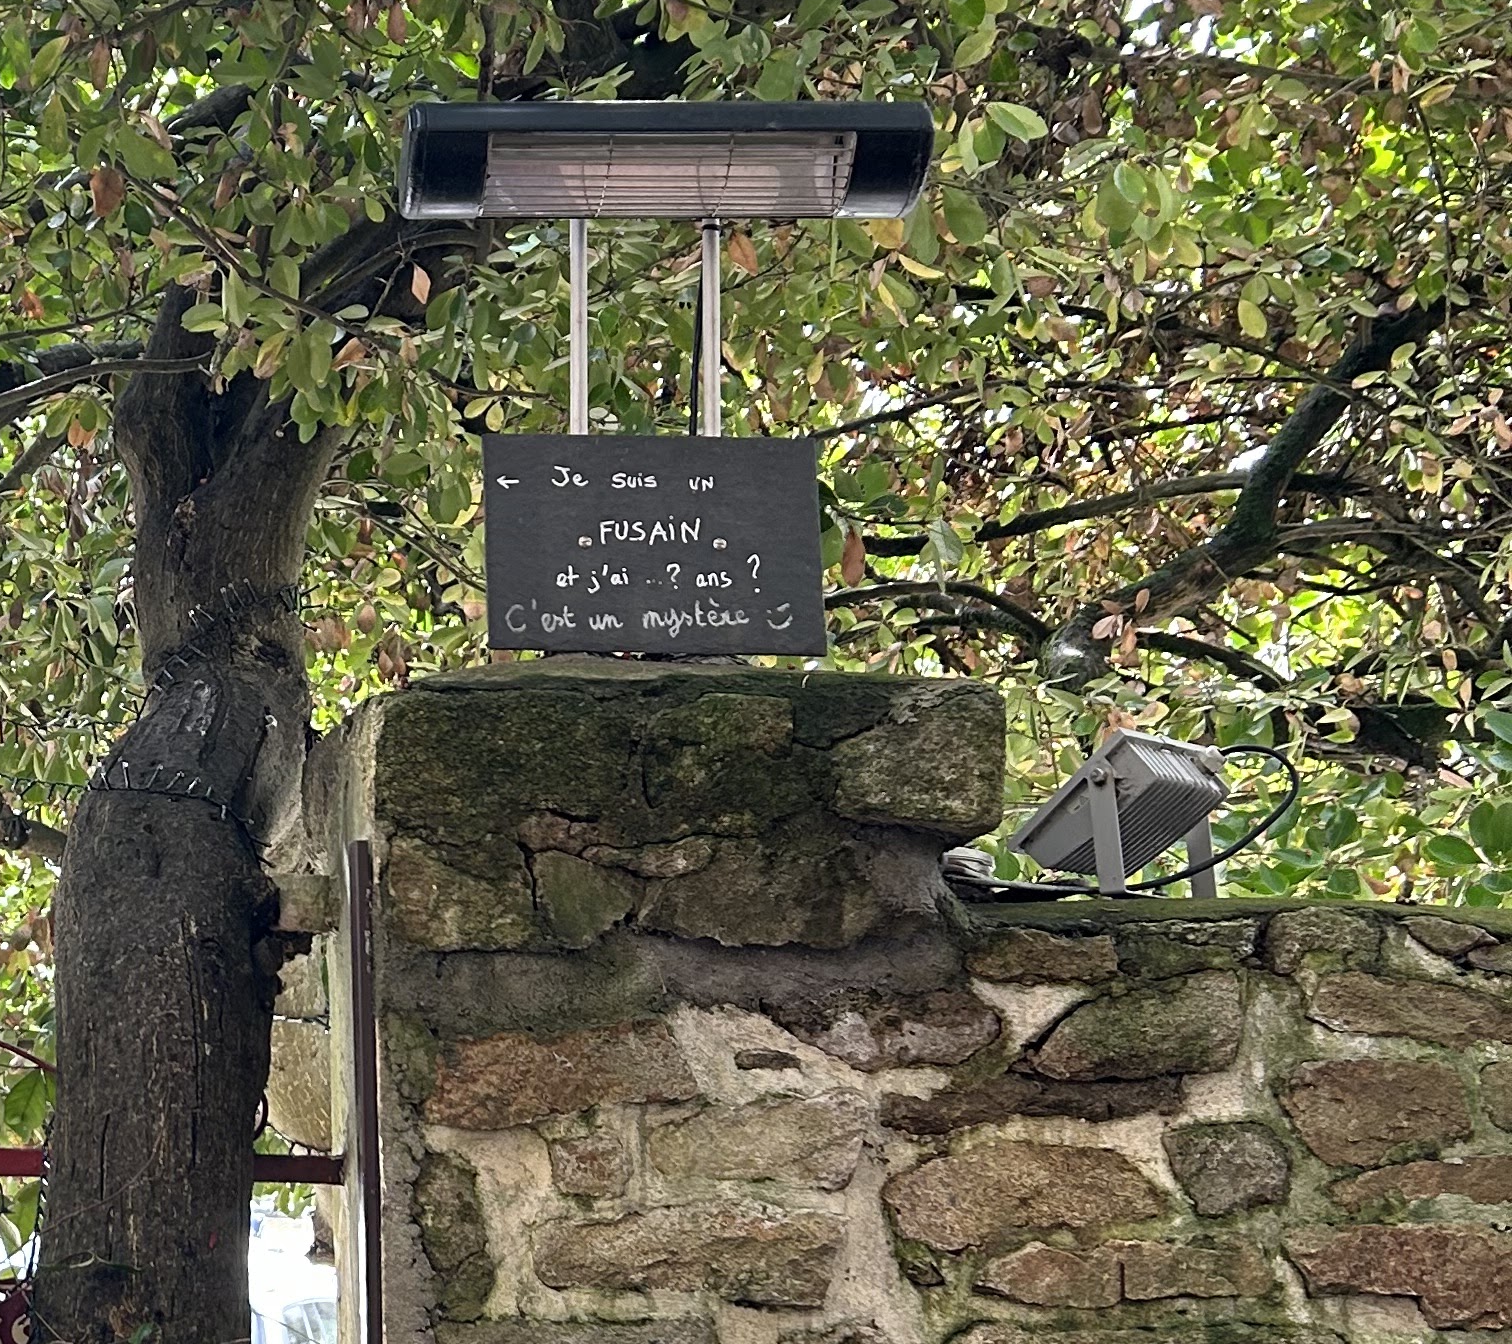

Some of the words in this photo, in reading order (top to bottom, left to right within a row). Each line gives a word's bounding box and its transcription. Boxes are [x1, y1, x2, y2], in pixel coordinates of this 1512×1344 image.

[551, 465, 589, 488] Je
[555, 564, 580, 587] et
[586, 563, 629, 594] j'ai
[695, 571, 733, 589] ans
[746, 553, 761, 594] ?
[505, 599, 576, 633] C'est
[588, 613, 623, 631] un
[641, 598, 750, 638] mystère
